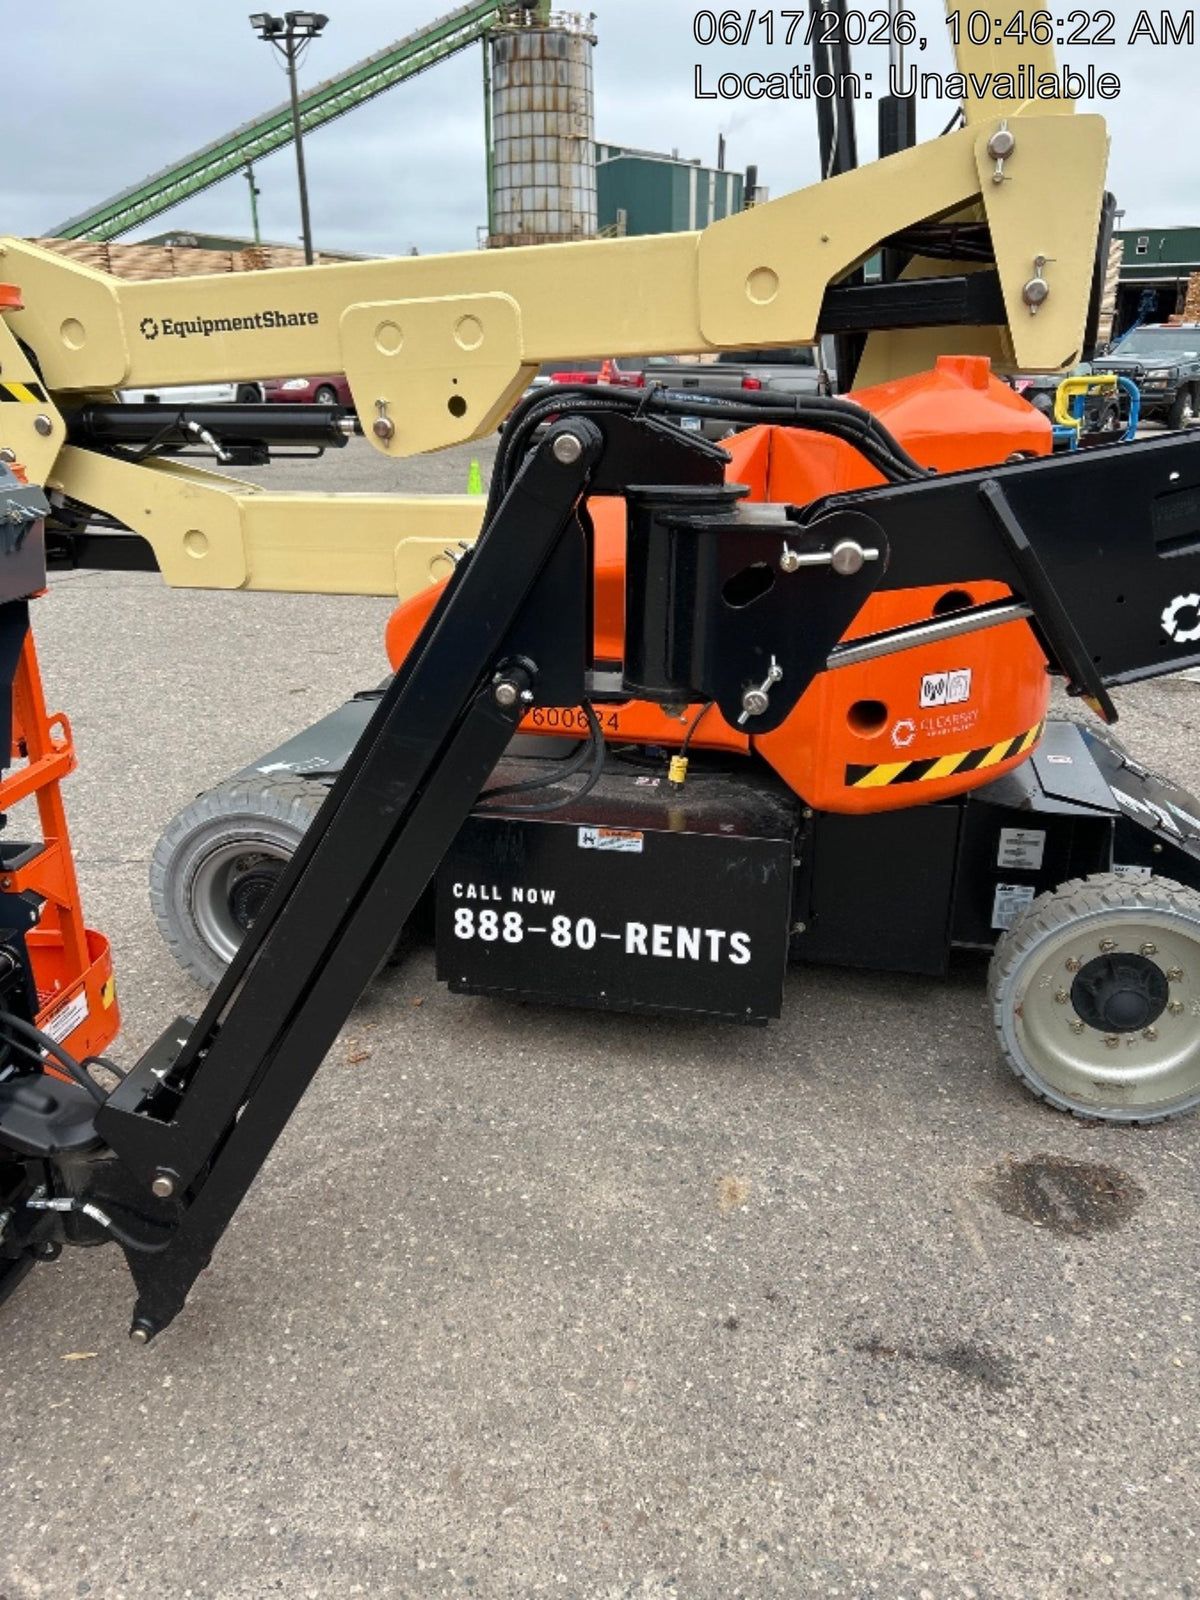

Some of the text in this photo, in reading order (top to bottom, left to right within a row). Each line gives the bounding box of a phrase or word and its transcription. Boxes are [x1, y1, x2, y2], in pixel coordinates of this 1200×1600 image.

[161, 311, 319, 338] EquipmentShare
[453, 883, 556, 905] CALL NOW
[454, 907, 752, 965] 888-80-RENTS
